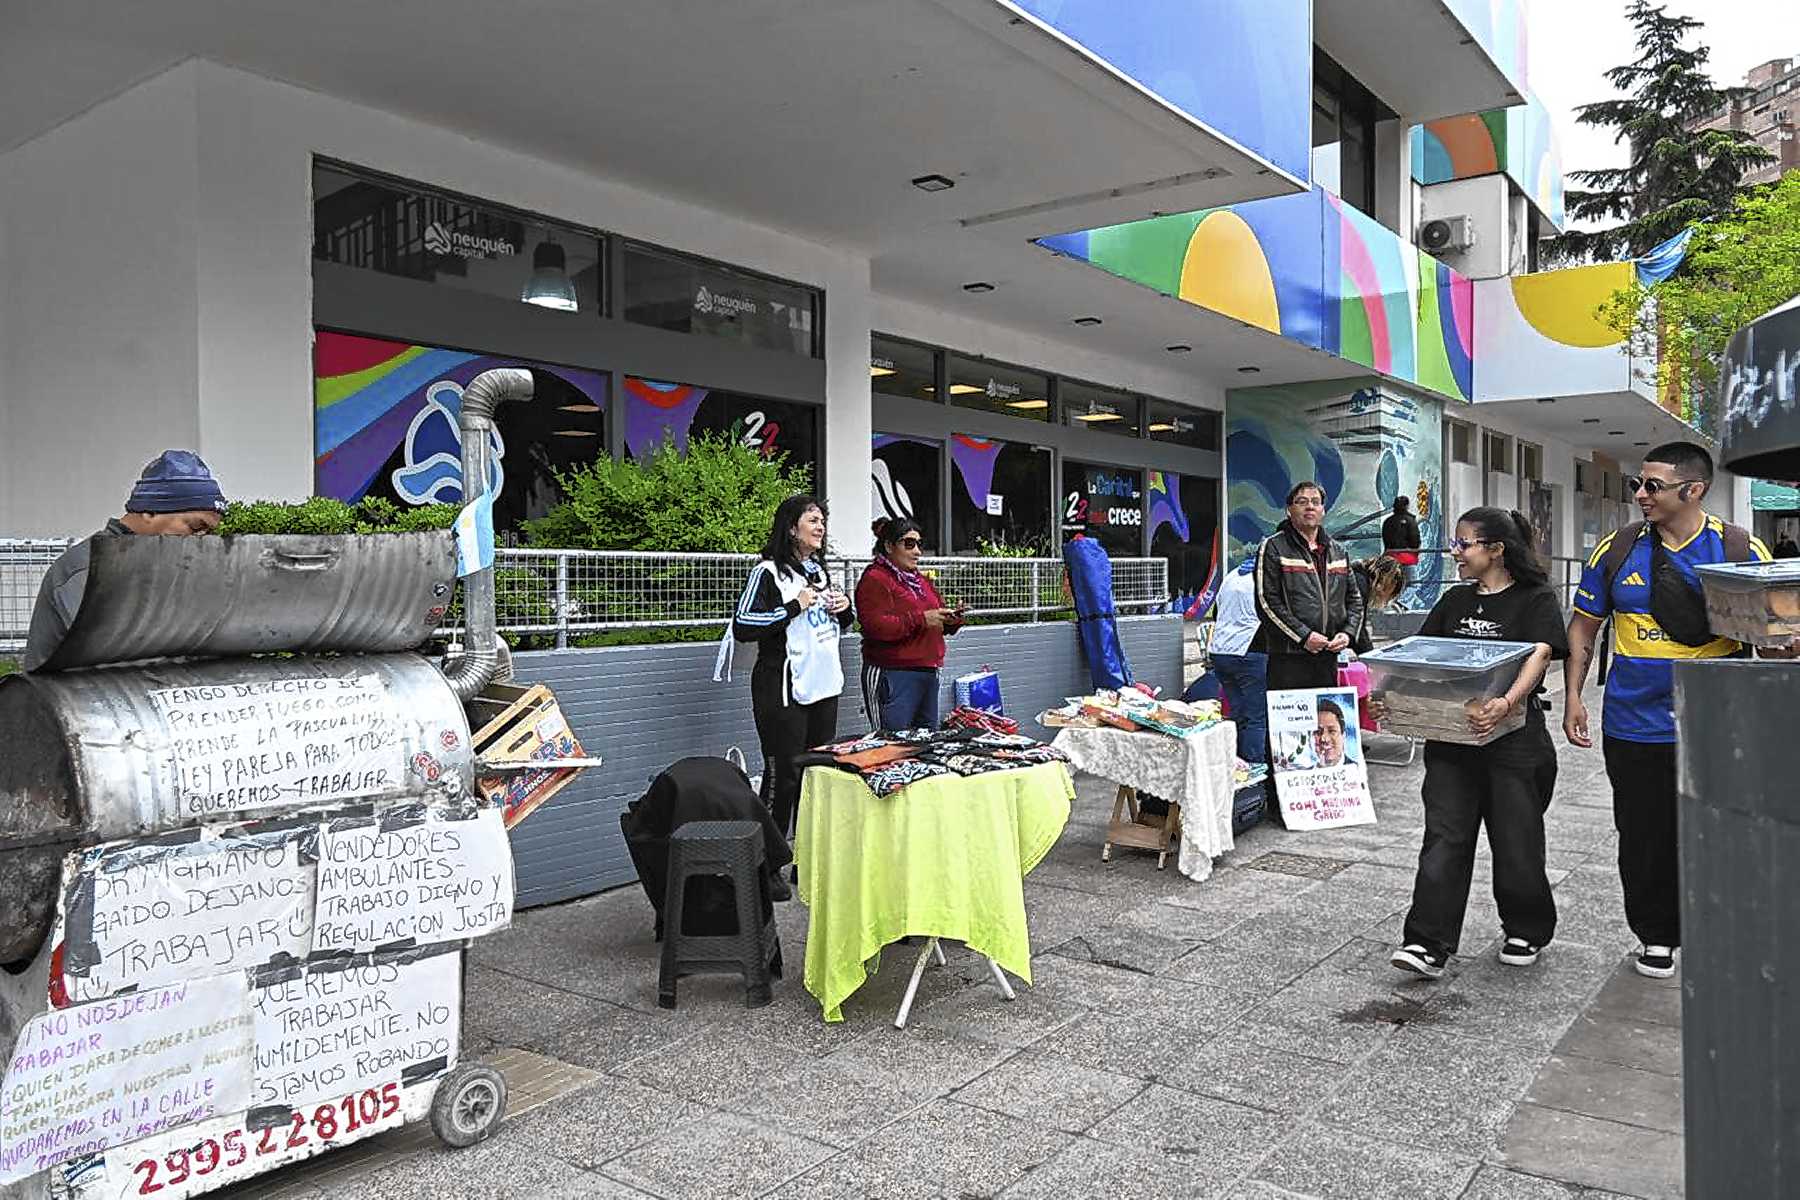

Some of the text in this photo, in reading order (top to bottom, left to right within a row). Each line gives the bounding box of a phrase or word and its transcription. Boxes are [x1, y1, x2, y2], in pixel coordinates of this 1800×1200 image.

[452, 232, 514, 256] neuquén
[1108, 507, 1141, 525] crece
[156, 686, 227, 707] TENGO
[168, 704, 260, 731] PRENDER
[174, 733, 240, 762] PRENDE
[257, 726, 278, 746] LA
[181, 764, 213, 795] LEY
[222, 750, 299, 787] PAREJA
[188, 768, 390, 813] QUEREMOS TRABAJAR
[321, 873, 502, 917] TRABAJO DIGNO Y
[104, 918, 281, 978] TRABAJAR
[273, 989, 393, 1035] TRABAJAR
[416, 1001, 451, 1030] NO
[353, 1037, 450, 1080] ROBANDO
[102, 1107, 122, 1128] EN
[159, 1078, 215, 1113] CALLE
[133, 1082, 401, 1196] 2995228105
